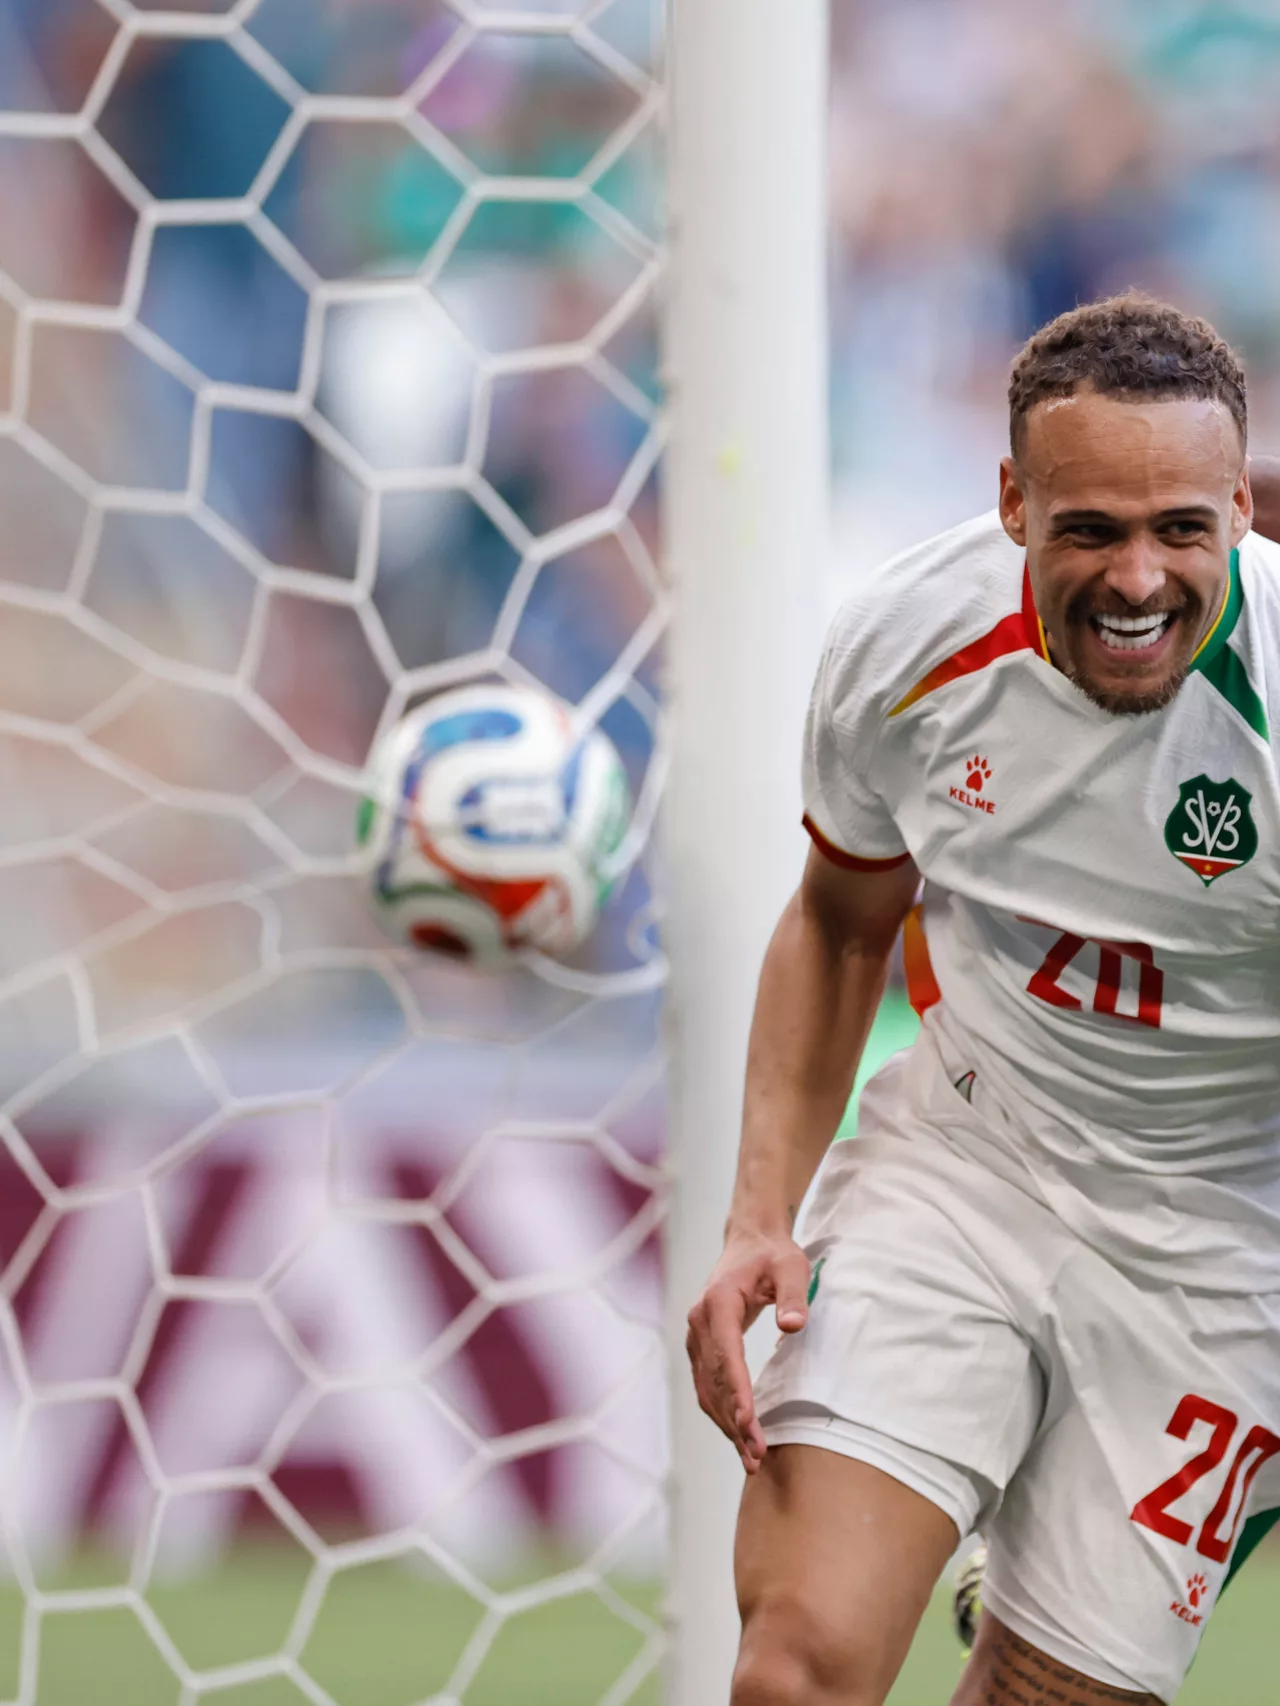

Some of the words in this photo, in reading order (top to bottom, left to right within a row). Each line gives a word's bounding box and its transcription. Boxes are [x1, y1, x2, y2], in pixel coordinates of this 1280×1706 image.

[949, 785, 996, 815] KELME
[1015, 914, 1164, 1029] 20
[1169, 1600, 1203, 1628] KELM
